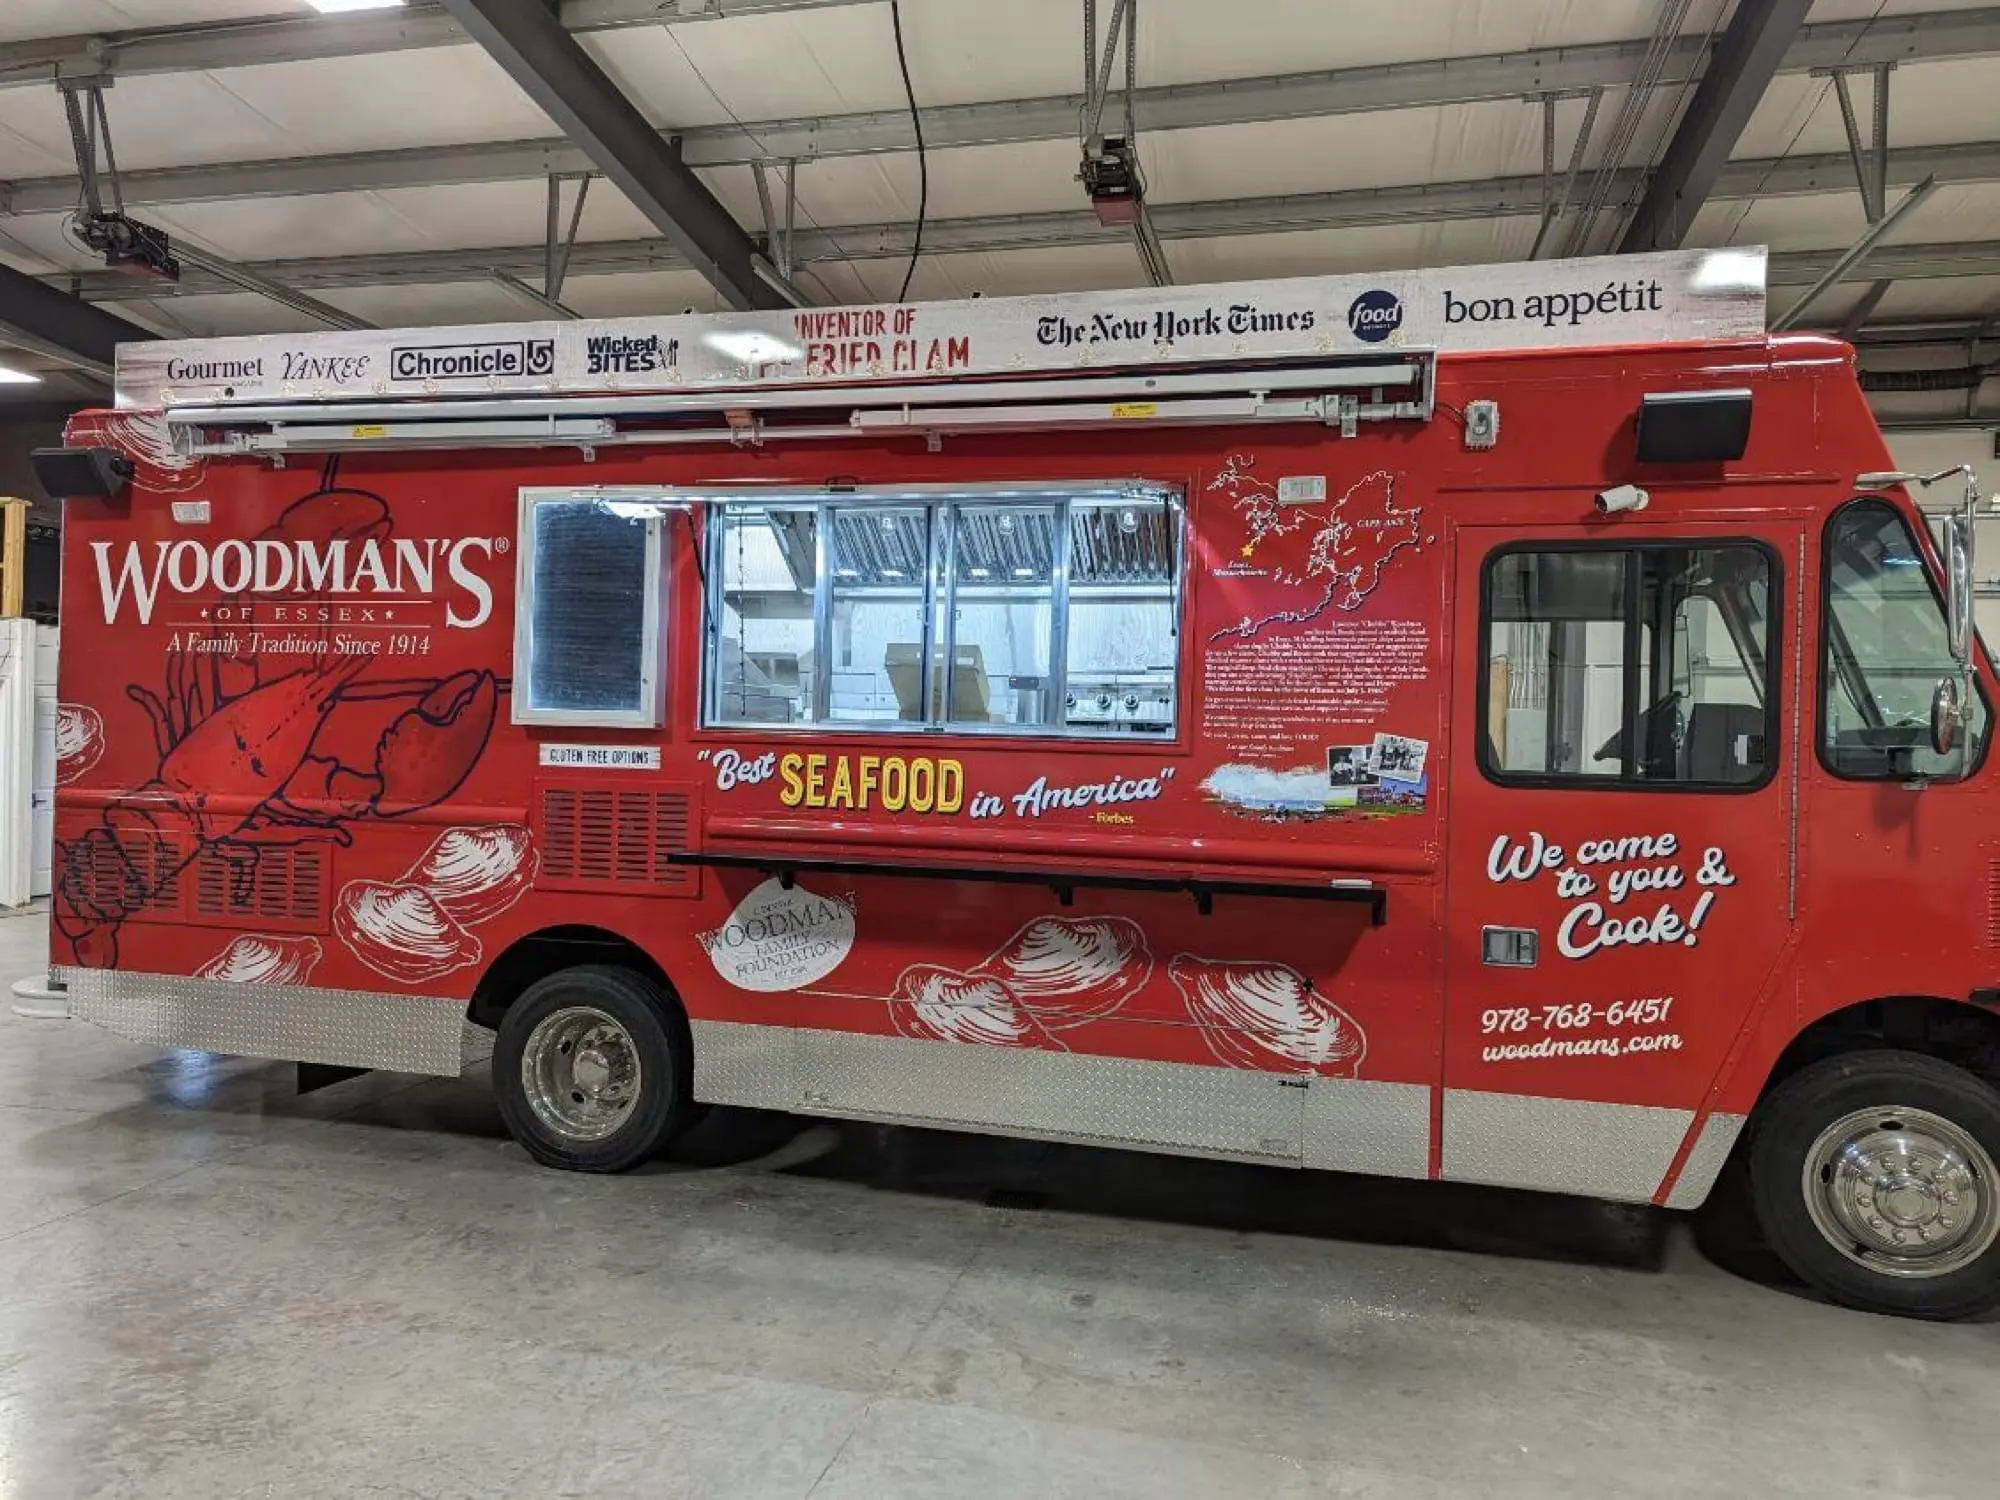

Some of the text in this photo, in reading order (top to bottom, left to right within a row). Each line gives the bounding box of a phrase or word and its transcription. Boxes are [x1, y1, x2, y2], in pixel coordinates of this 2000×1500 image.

[1351, 300, 1399, 331] food
[1444, 279, 1663, 326] bon appétit
[894, 308, 917, 335] OF
[1037, 303, 1315, 347] The New York Times
[528, 340, 552, 374] 5
[587, 335, 658, 354] Wicked
[167, 357, 264, 380] Gourmet
[280, 352, 371, 384] YANKEE
[398, 349, 517, 376] Chronicle
[217, 607, 376, 622] OF ESSEX
[165, 634, 431, 659] A Family Tradition Since 1914
[550, 748, 649, 764] GLUTEN FREE OPTIONS
[779, 752, 965, 815] SEAFOOD
[969, 790, 1005, 819] in
[1487, 831, 1678, 882] We come
[1555, 847, 1736, 903] to you &
[1557, 890, 1714, 959] Cook!
[735, 938, 841, 977] FOUNDATION
[755, 929, 811, 957] FAMILY
[1481, 996, 1674, 1034] 978-768-6451
[1481, 1031, 1684, 1062] woodmans.com
